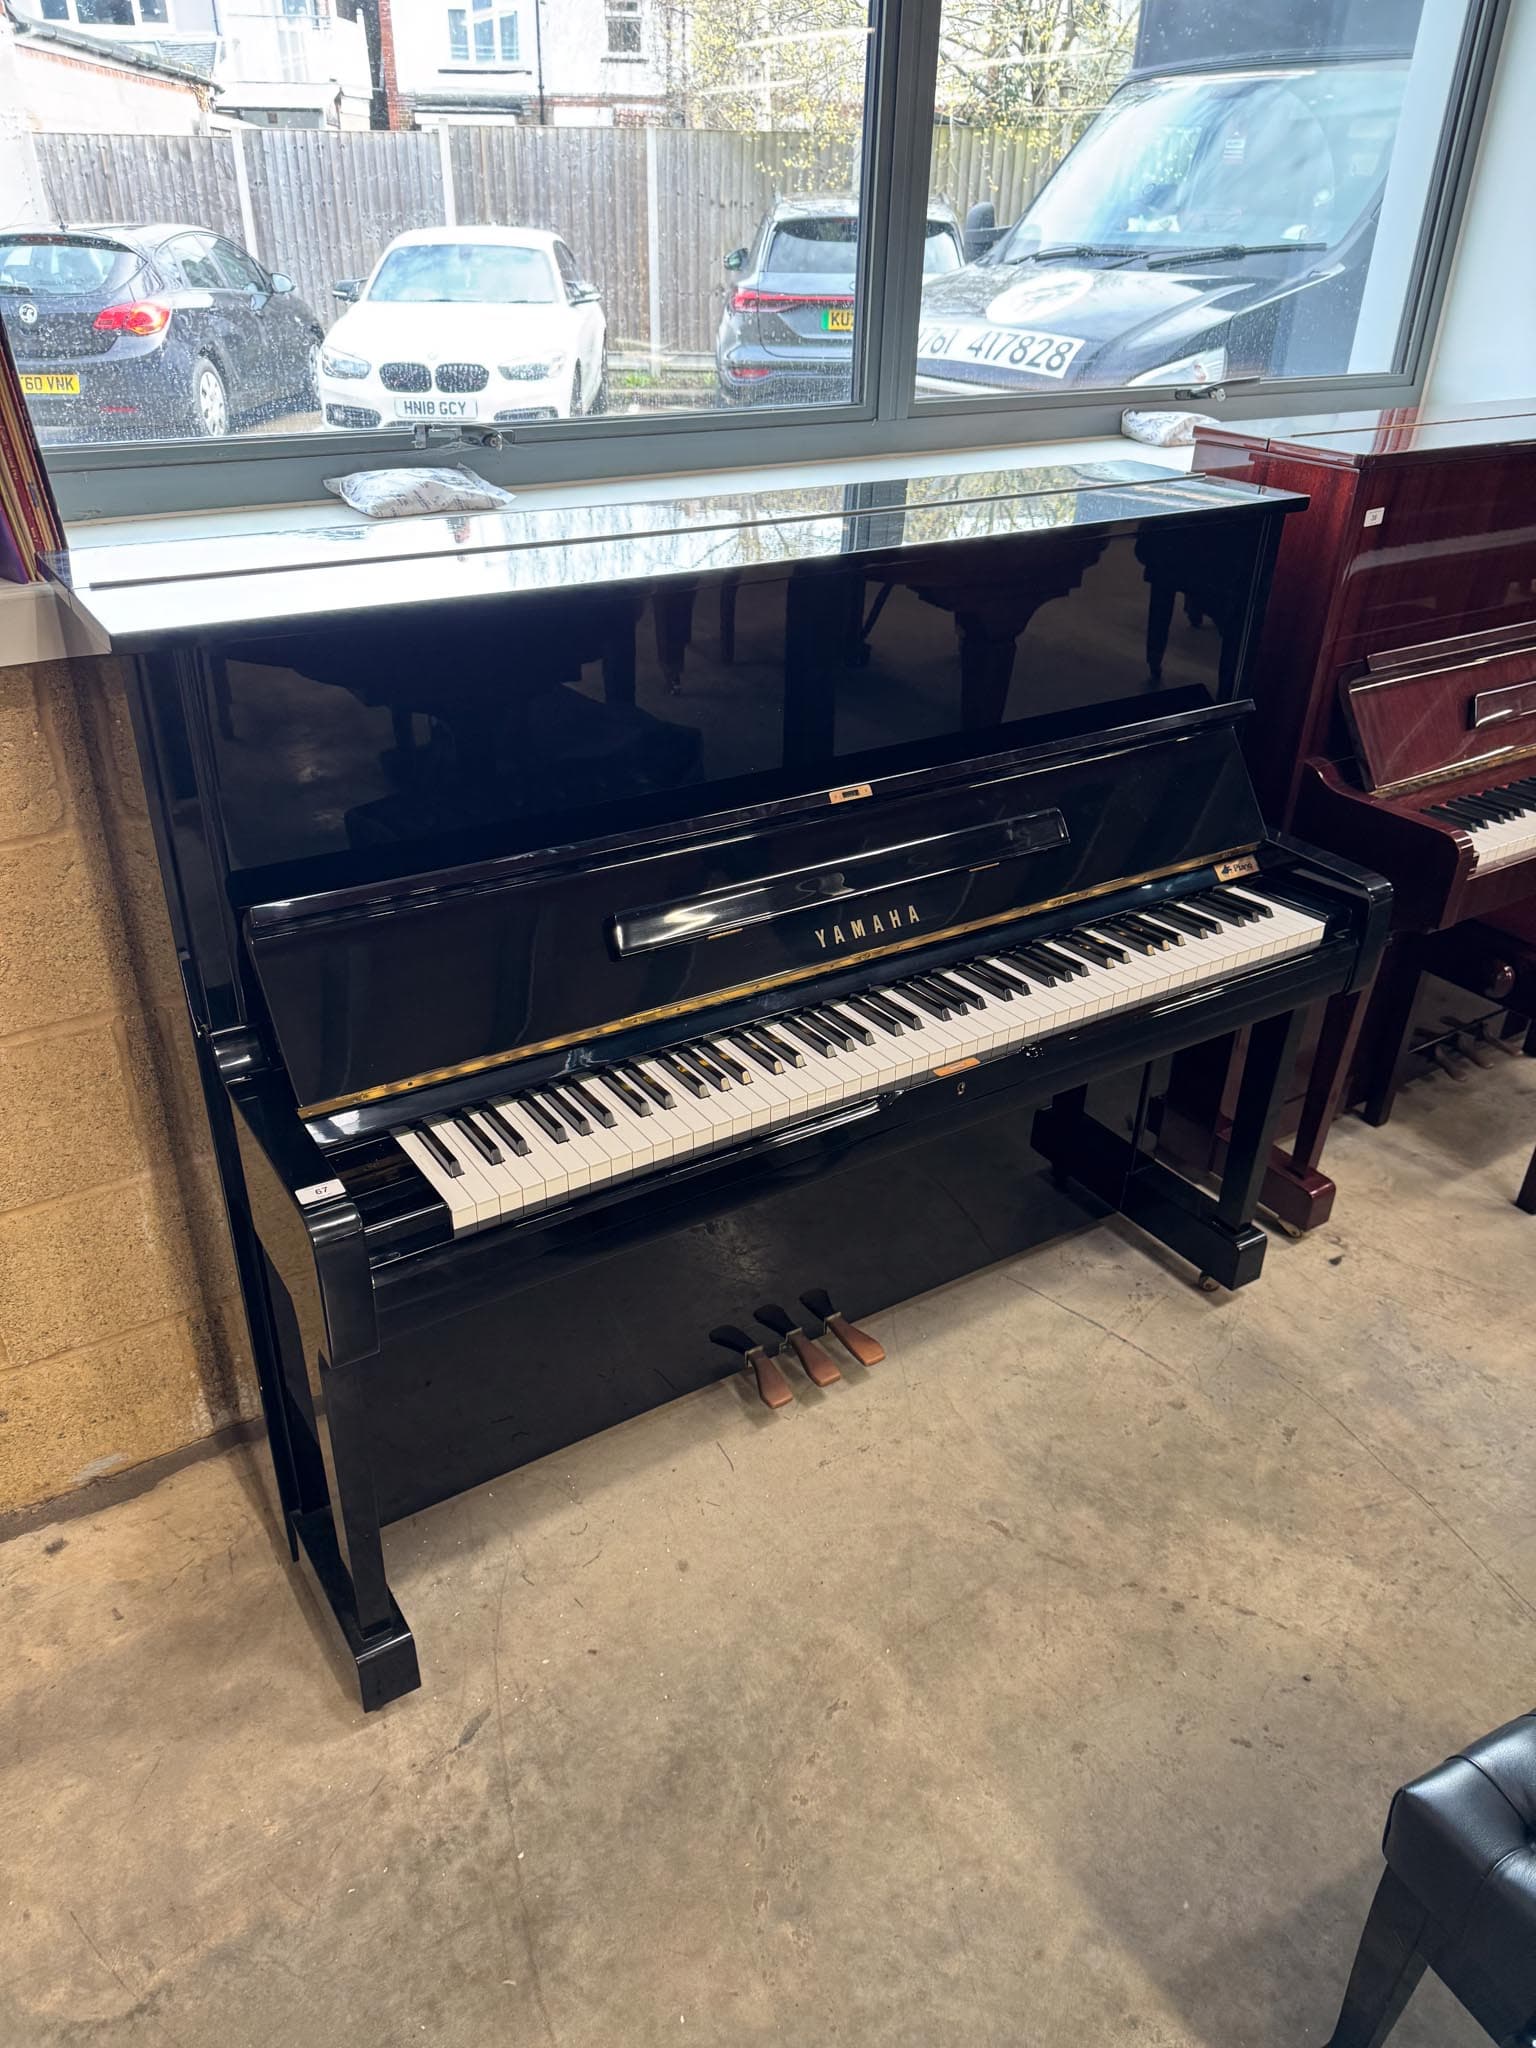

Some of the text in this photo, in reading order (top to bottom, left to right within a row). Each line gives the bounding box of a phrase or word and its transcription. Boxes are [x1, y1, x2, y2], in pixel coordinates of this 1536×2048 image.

[831, 311, 854, 327] KU
[967, 330, 1075, 372] 417828
[46, 376, 74, 391] VNK
[403, 400, 466, 415] HN18 GCY
[814, 904, 921, 949] YAMAHA
